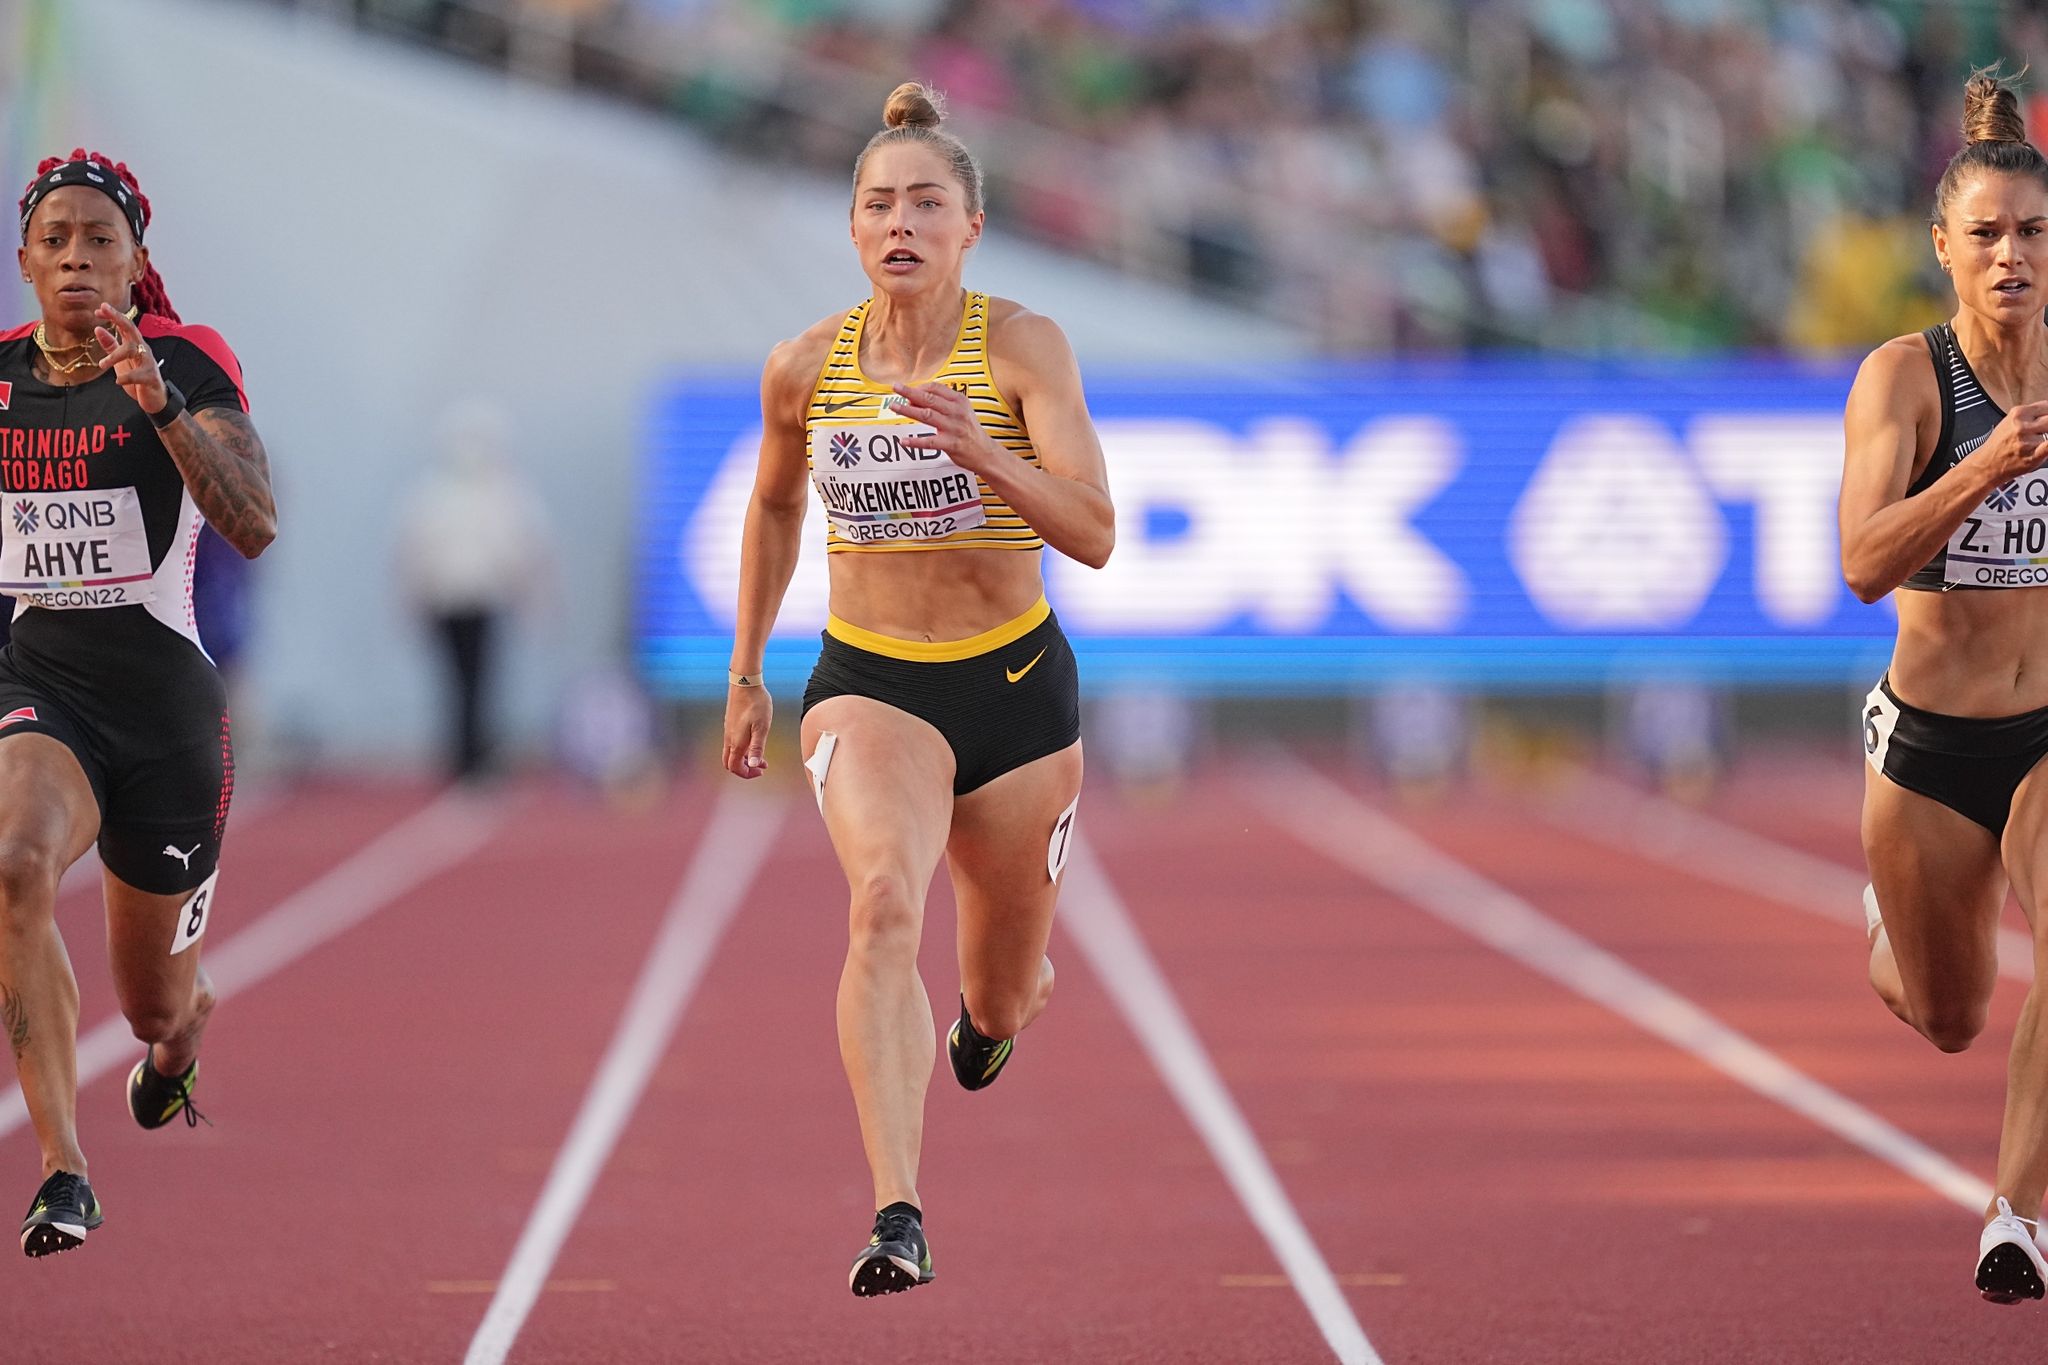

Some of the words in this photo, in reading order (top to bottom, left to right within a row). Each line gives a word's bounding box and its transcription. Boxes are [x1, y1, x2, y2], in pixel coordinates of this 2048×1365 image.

[0, 425, 105, 458] TRINIDAD
[1, 459, 88, 490] TOBAGO
[822, 473, 973, 513] LÜCKENKEMPER
[45, 501, 116, 530] QNB
[848, 517, 957, 541] OREGON22
[1960, 518, 1989, 552] Z.
[2004, 518, 2046, 554] HO
[24, 539, 112, 577] AHYE
[1976, 567, 2048, 585] OREGO
[1865, 705, 1883, 754] 6
[187, 890, 207, 937] 8
